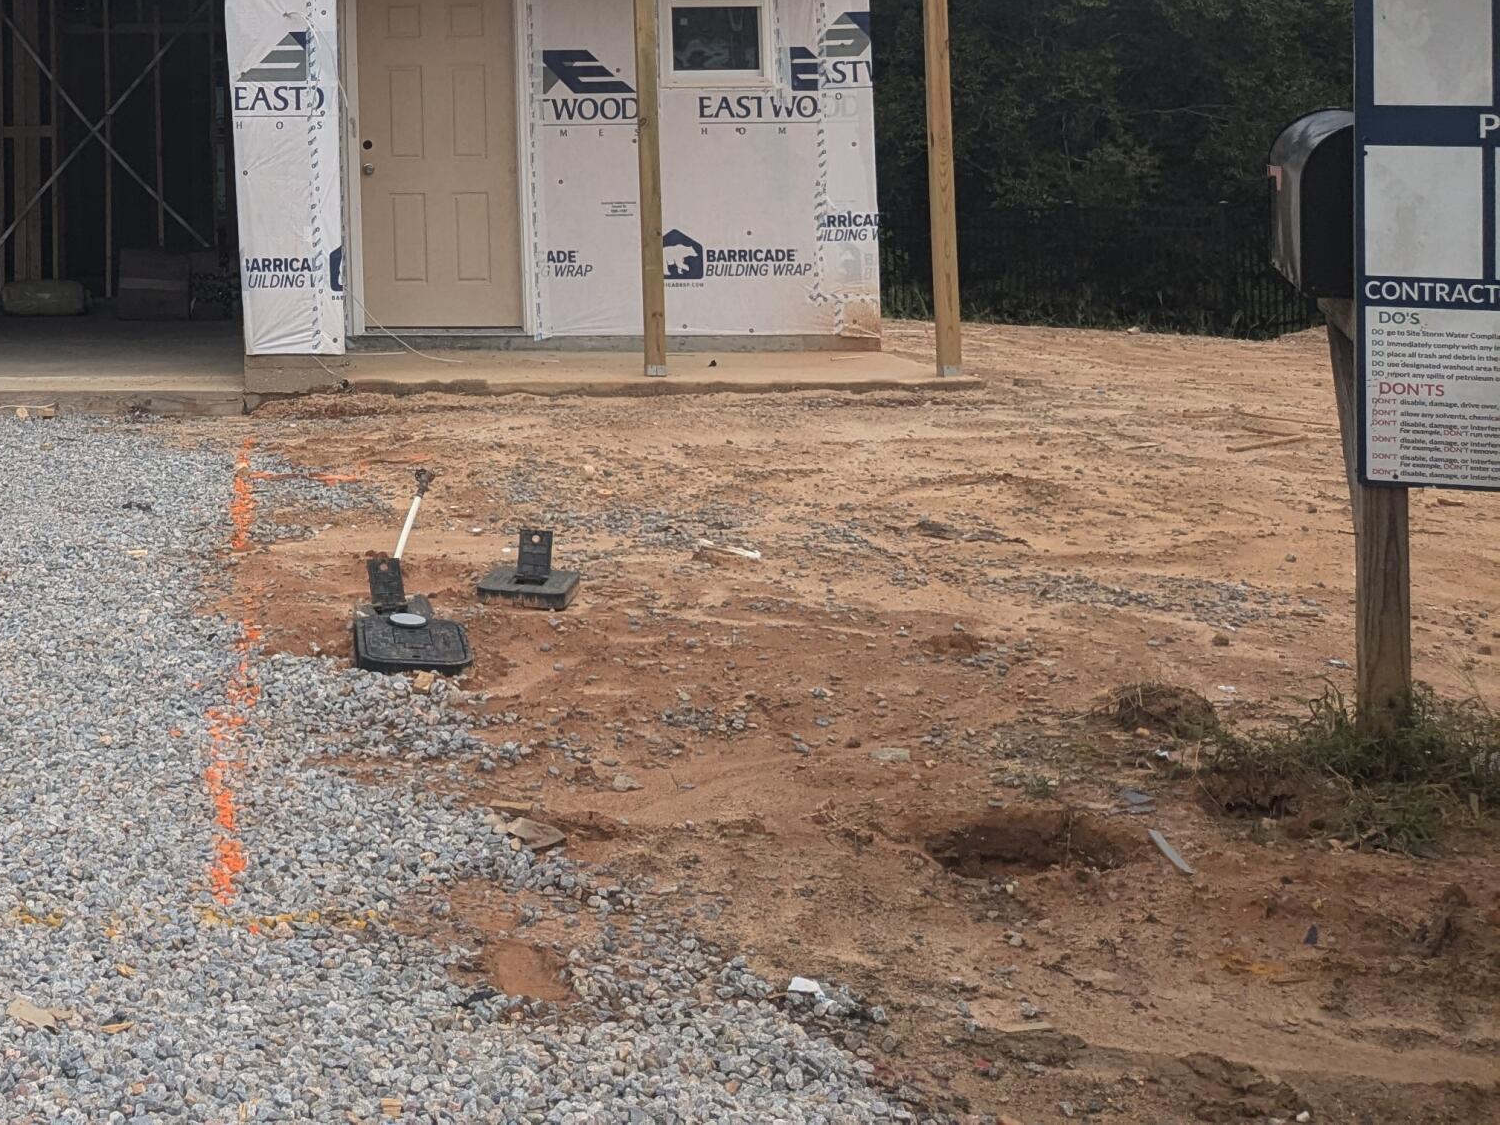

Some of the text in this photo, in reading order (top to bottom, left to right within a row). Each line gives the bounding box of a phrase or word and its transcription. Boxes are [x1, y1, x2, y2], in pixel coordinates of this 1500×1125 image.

[706, 249, 796, 263] BARRICADE
[554, 264, 593, 277] WRAP
[705, 263, 812, 277] BUILDING WRAP
[1365, 280, 1500, 303] CONTRACT
[1378, 311, 1420, 325] DO'S
[1379, 382, 1445, 396] DON'TS
